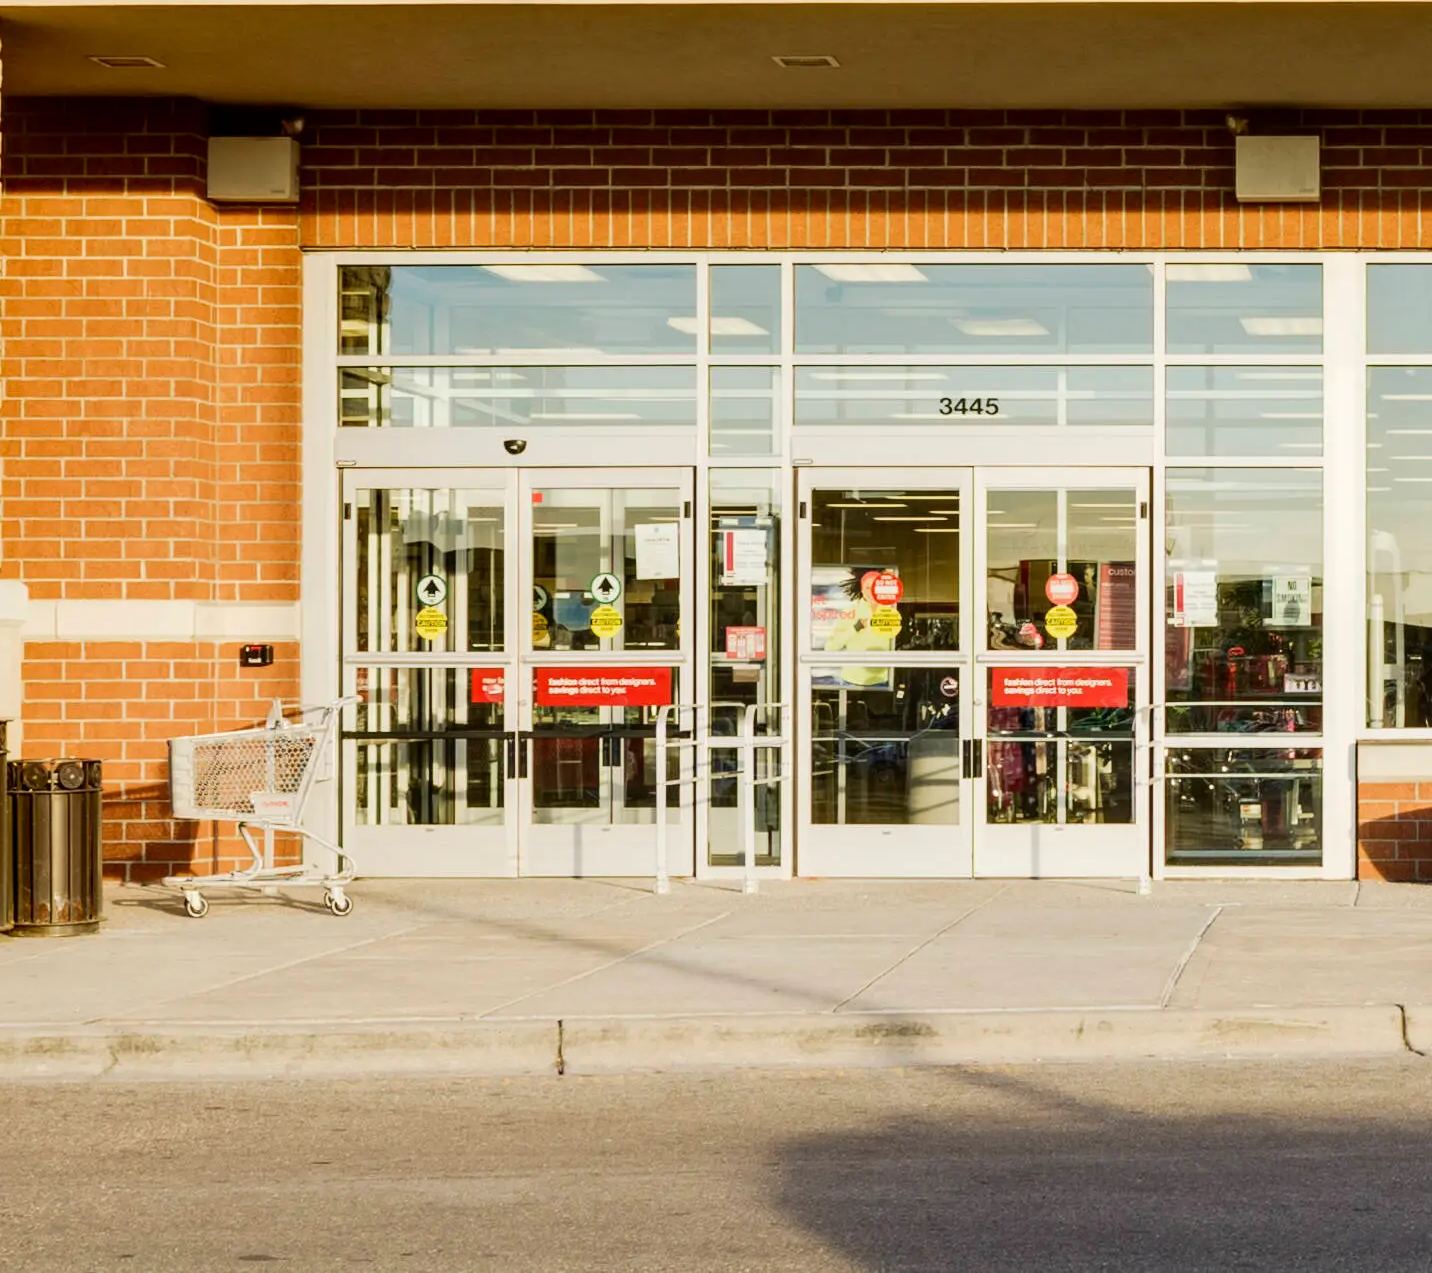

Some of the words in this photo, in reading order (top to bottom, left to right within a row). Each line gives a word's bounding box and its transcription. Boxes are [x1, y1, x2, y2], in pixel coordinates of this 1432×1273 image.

[939, 397, 999, 415] 3445
[1108, 568, 1135, 576] custo
[1287, 580, 1297, 590] NO
[548, 678, 578, 686] fashion
[578, 678, 599, 686] direct
[600, 677, 618, 686] from
[1004, 678, 1034, 686] fashion
[1034, 678, 1055, 686] direct
[1057, 678, 1074, 686] from
[548, 686, 579, 695] savings
[580, 686, 601, 694] direct
[601, 686, 610, 694] to
[1004, 687, 1034, 696] savings
[1035, 686, 1057, 694] direct
